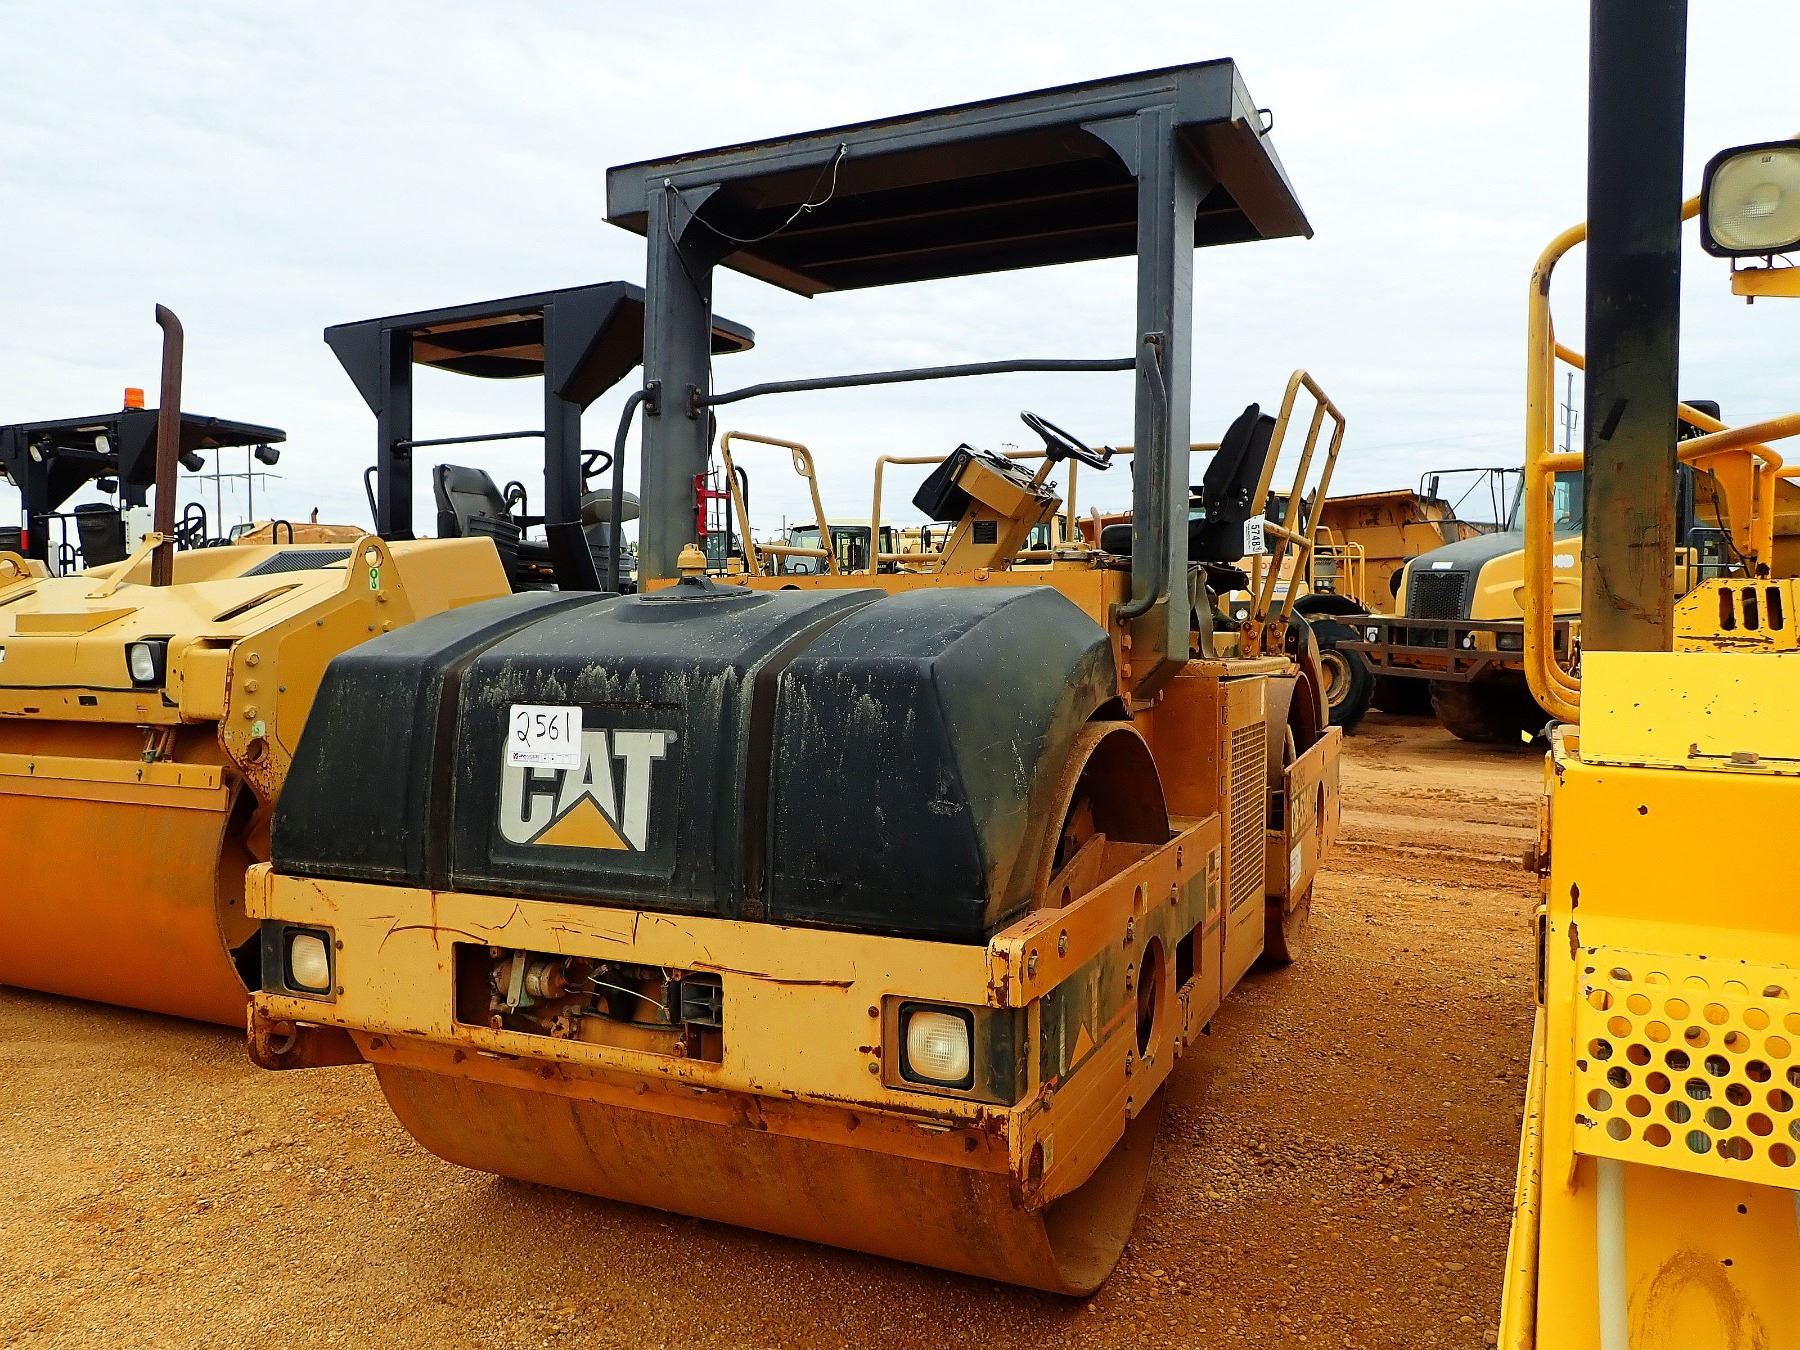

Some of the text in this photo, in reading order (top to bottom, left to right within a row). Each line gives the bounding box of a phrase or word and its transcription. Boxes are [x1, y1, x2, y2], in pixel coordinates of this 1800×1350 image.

[1251, 524, 1261, 546] 5748
[516, 711, 571, 748] 2561
[499, 728, 668, 852] CAT
